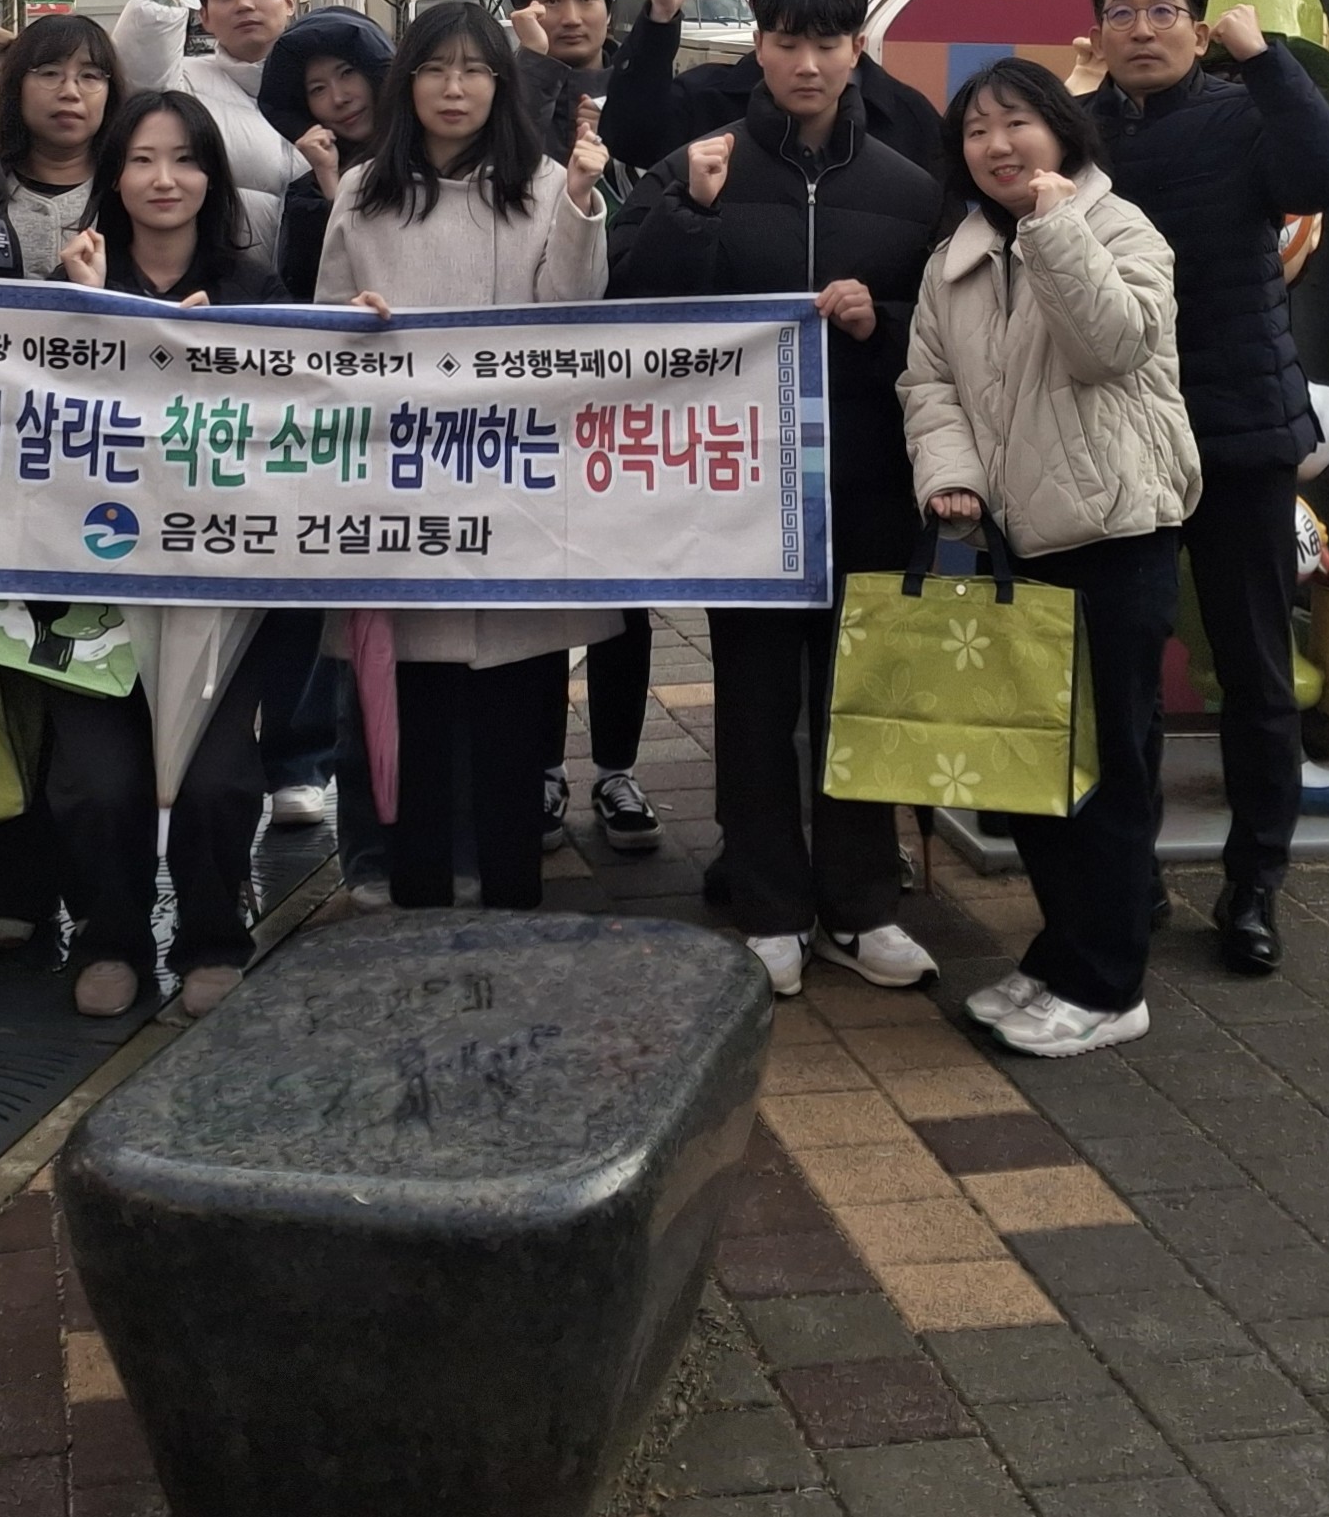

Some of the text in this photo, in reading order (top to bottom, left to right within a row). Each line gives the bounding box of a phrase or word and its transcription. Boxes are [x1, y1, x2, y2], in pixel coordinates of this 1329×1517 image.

[22, 336, 126, 371] 이용하기
[185, 346, 296, 377] 전통시장
[307, 350, 414, 377] 이용하기
[472, 348, 632, 379] 음성행복페이
[644, 347, 744, 377] 이용하기
[16, 389, 146, 484] 살리는
[160, 394, 254, 487] 착한
[266, 403, 372, 482] 소비!
[389, 401, 560, 490] 함께하는
[574, 402, 760, 493] 행복나눔!
[160, 512, 493, 556] 음성군 건설교통과
